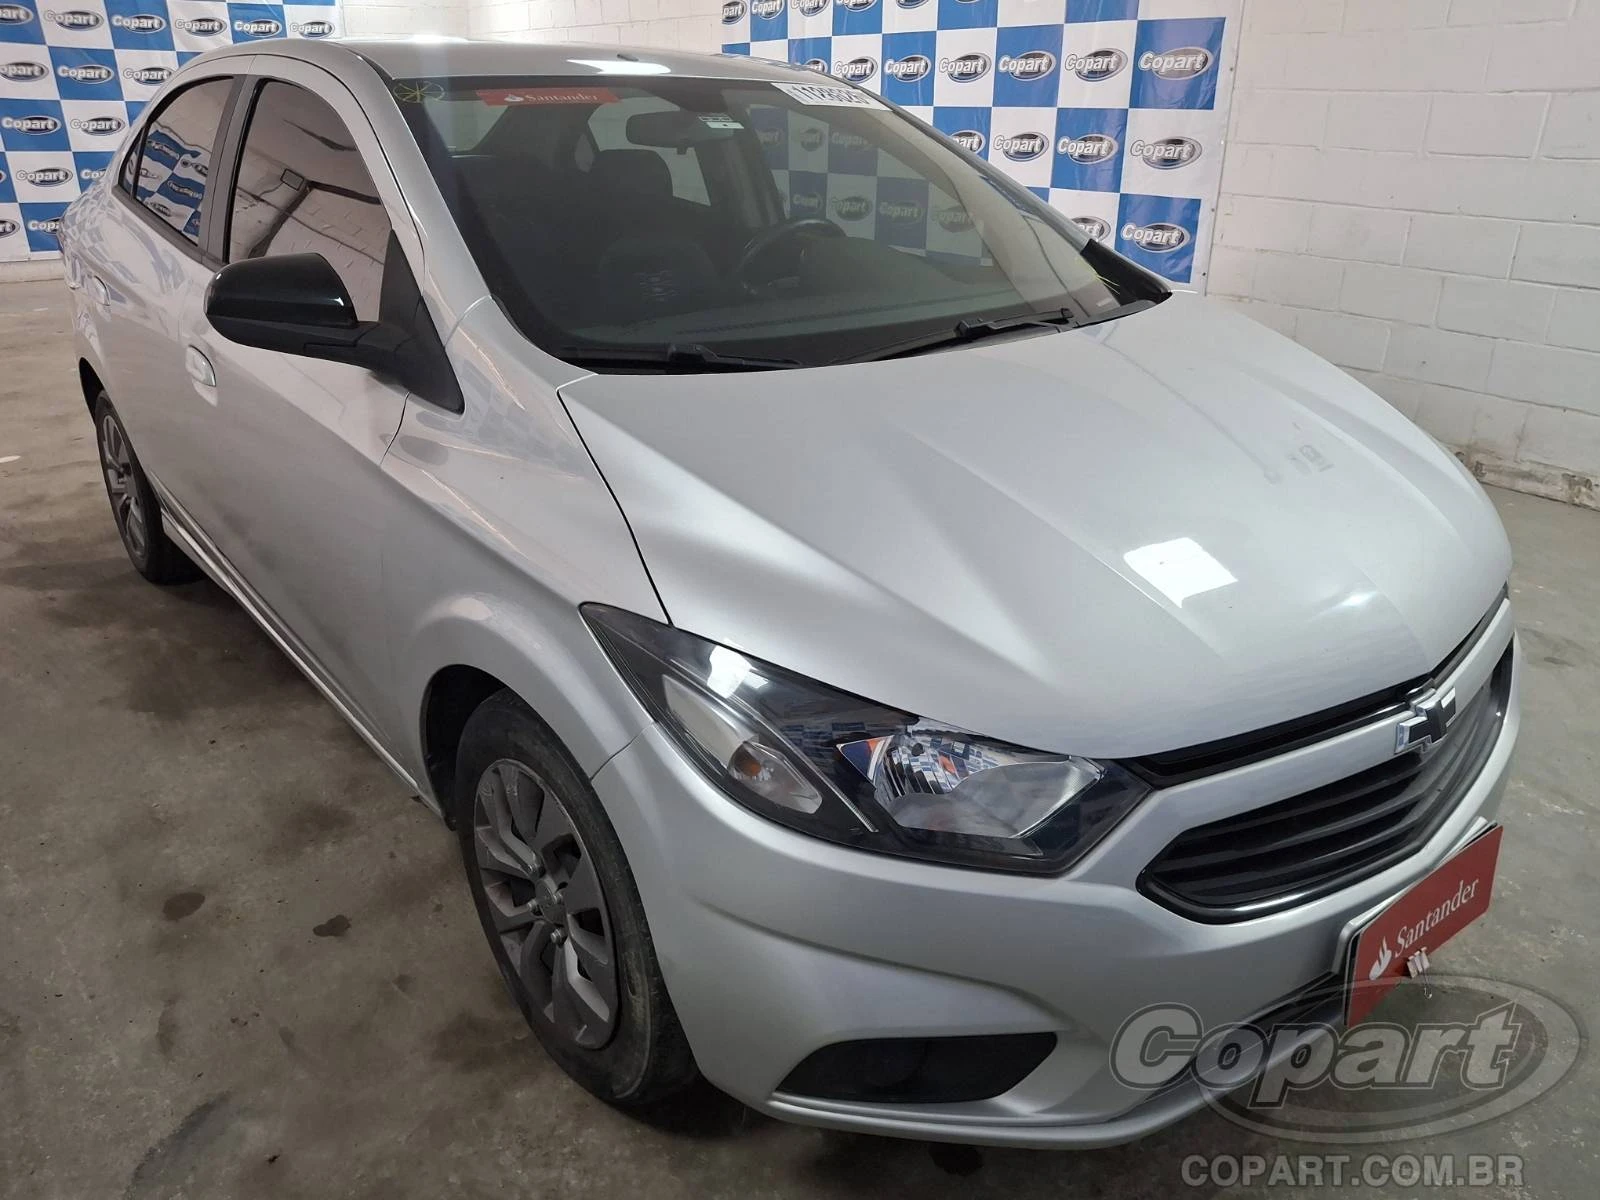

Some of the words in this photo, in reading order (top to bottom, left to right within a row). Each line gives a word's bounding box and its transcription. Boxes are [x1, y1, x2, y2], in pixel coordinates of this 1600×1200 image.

[45, 10, 96, 26] Copart
[112, 15, 160, 29] Copart
[175, 19, 220, 32] Copart
[234, 21, 277, 34] Copart
[290, 23, 329, 35] Copart
[834, 60, 872, 77] Copart
[884, 58, 926, 76] Copart
[939, 57, 984, 77] Copart
[999, 55, 1049, 76] Copart
[1065, 53, 1118, 76] Copart
[1138, 51, 1203, 74] Copart
[58, 66, 108, 80] Copart
[123, 68, 169, 81] Copart
[524, 91, 599, 102] Santander
[2, 116, 54, 130] Copart
[70, 118, 117, 131] Copart
[993, 135, 1040, 156] Copart
[1057, 136, 1109, 158] Copart
[1130, 140, 1192, 161] Copart
[16, 170, 65, 182] Copart
[1120, 222, 1182, 245] Copart
[1394, 877, 1479, 958] Santander
